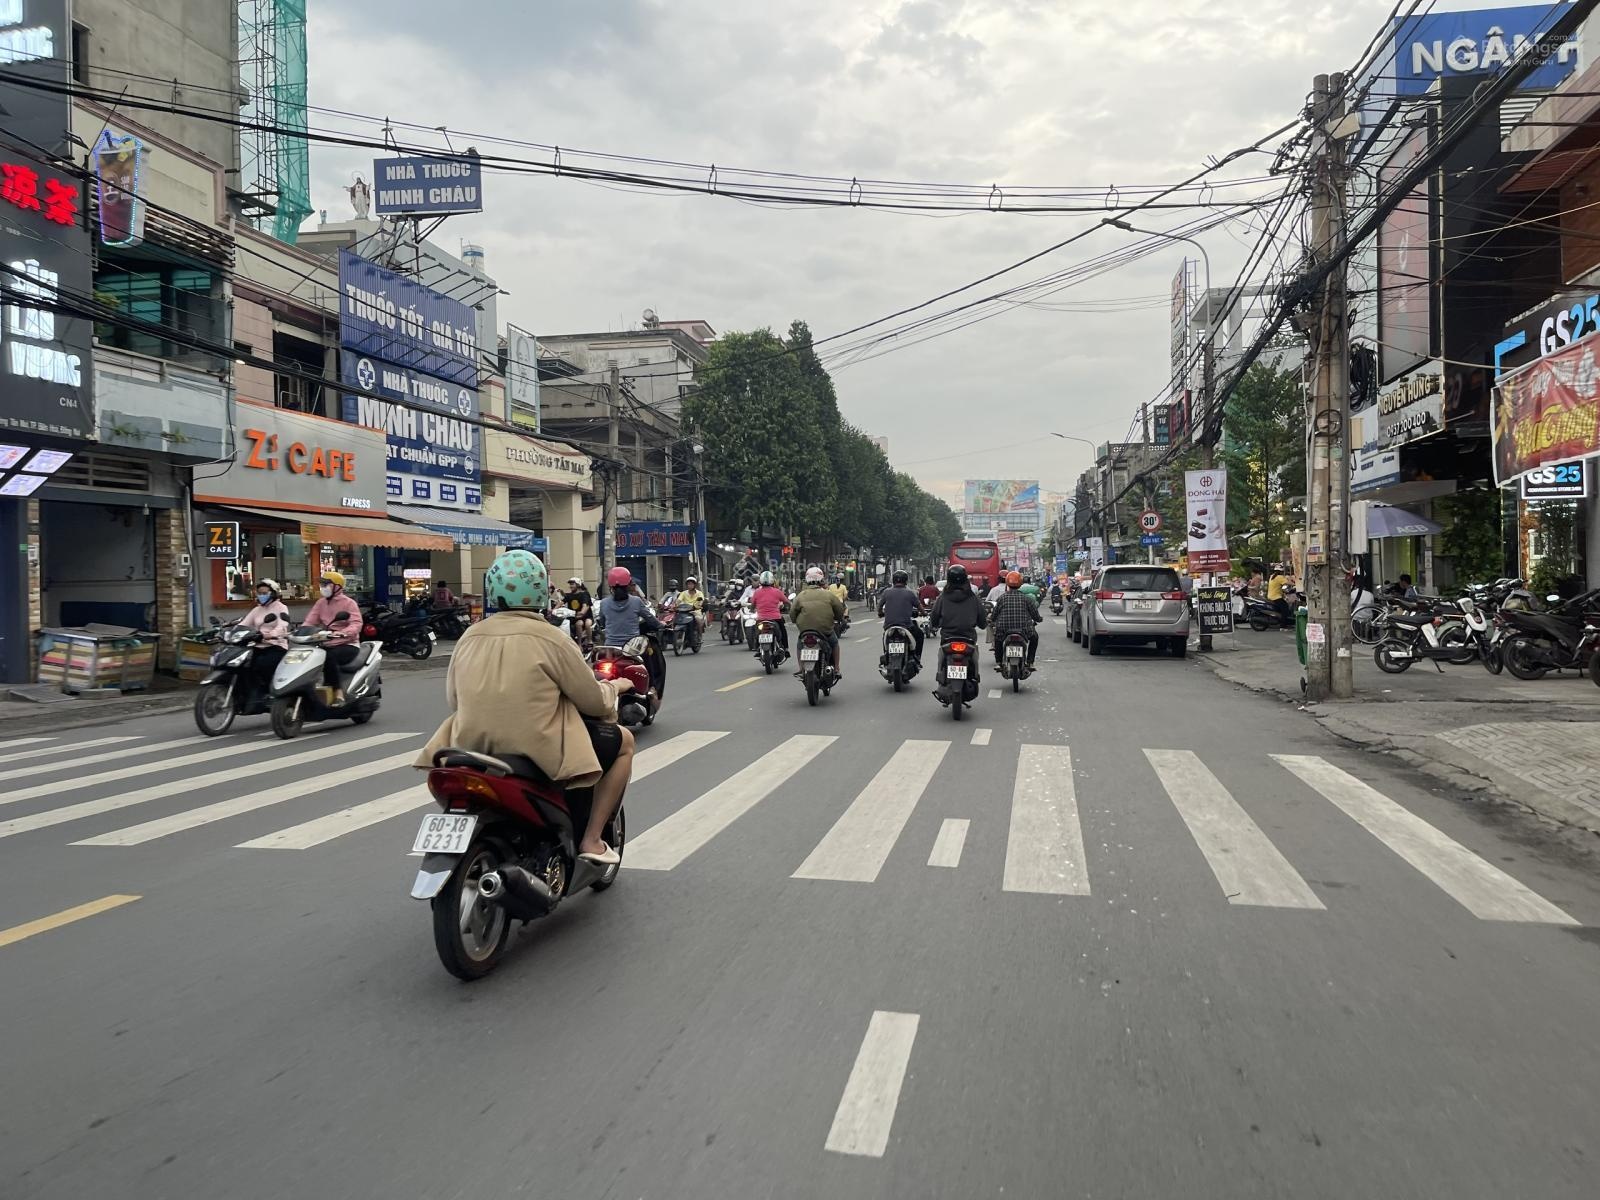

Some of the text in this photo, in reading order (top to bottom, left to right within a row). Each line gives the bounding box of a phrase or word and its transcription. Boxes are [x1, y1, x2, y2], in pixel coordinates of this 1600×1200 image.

[386, 160, 471, 181] NHÀ THUỐC
[379, 184, 477, 206] MINH CHÂU
[345, 283, 397, 330] THUỐC
[399, 303, 424, 341] TỐT
[432, 317, 453, 351] GIÁ
[455, 325, 476, 360] TỐT
[382, 370, 449, 405] NHÀ THUỐC
[59, 397, 78, 408] CN4
[358, 397, 474, 452] MINH CHÂU
[288, 441, 356, 482] CAFE
[386, 445, 458, 469] ẠT CHUẨN GPP
[505, 444, 585, 476] PHƯỜNG TÂN MAI
[1526, 465, 1581, 484] GS25
[342, 497, 372, 509] EXPRESS
[428, 817, 469, 832] 60-X8
[422, 833, 463, 850] 6231
